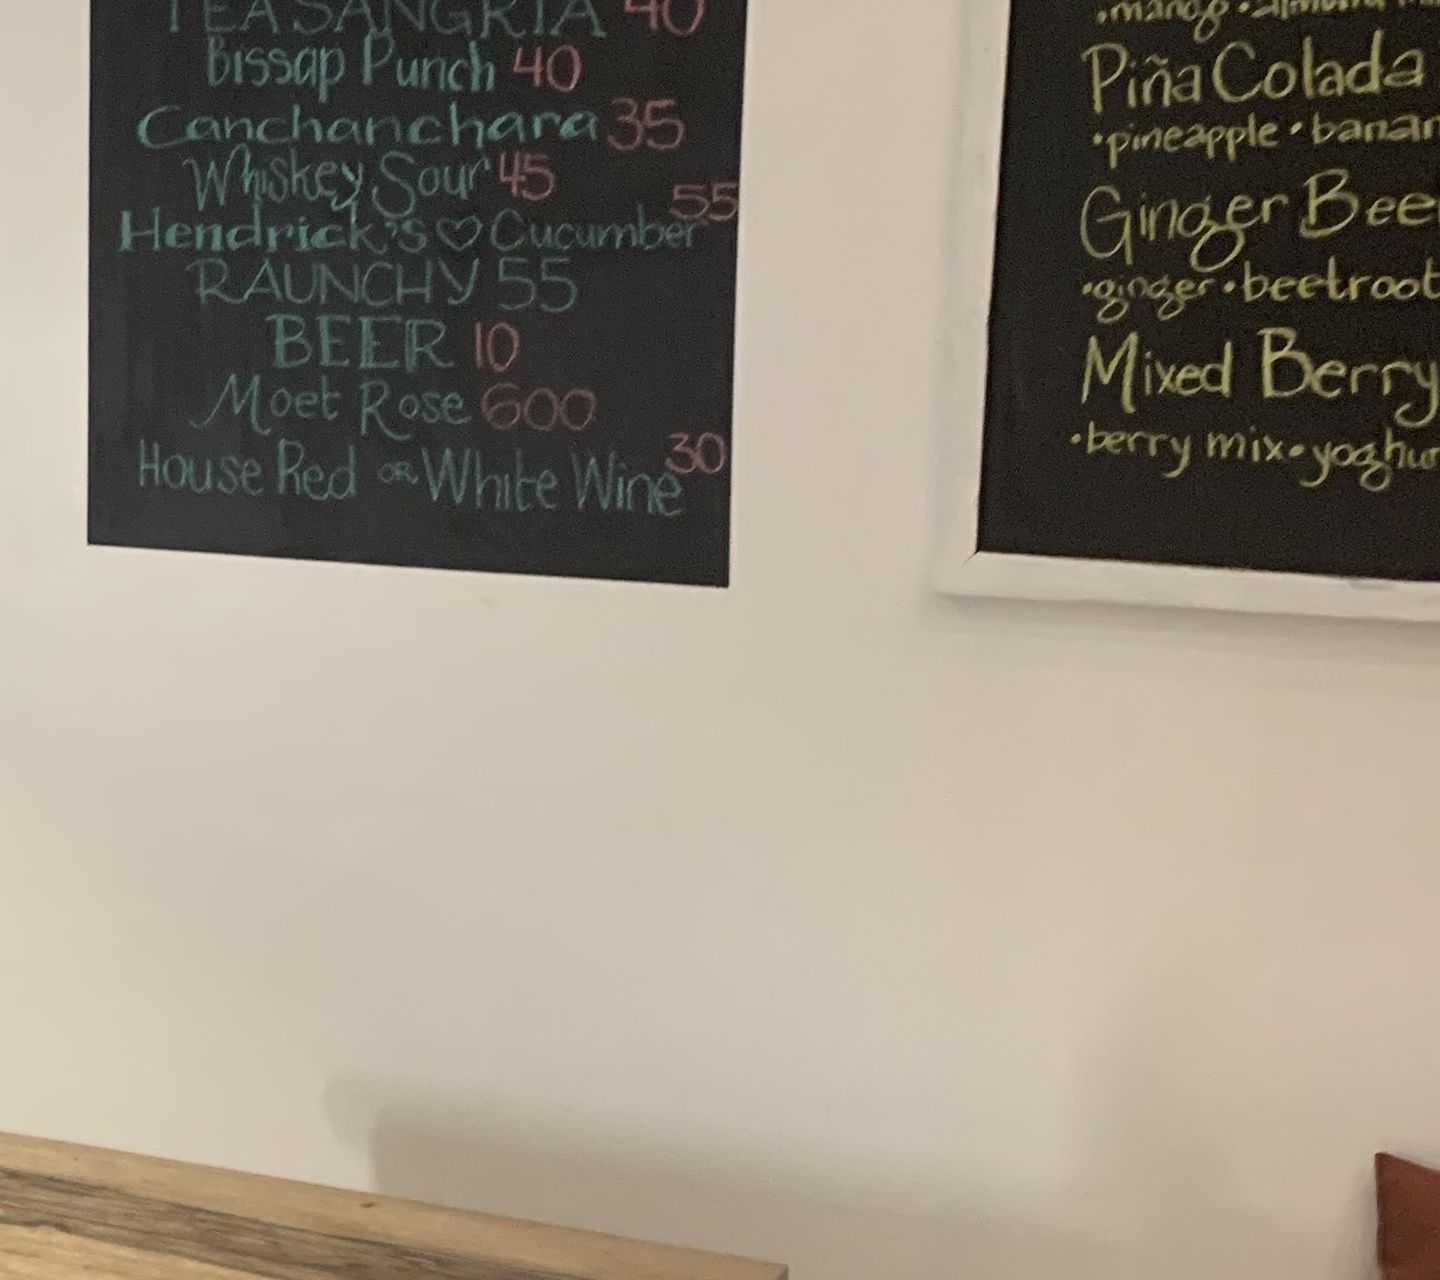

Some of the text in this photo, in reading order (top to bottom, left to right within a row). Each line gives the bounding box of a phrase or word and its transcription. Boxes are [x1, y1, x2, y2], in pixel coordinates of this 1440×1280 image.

[207, 29, 583, 105] Bissap Punch 40
[1080, 28, 1425, 115] Piña Colada
[136, 96, 687, 152] Canchanchara 35
[1105, 112, 1280, 170] pineapple
[182, 142, 557, 220] Whiskey Sour 45
[116, 181, 741, 256] Hendrick's Cucumber 55
[1079, 168, 1440, 273] Ginger Bee
[186, 256, 579, 314] RAUNCHY 55
[1087, 256, 1440, 325] ginger beetroot
[262, 312, 521, 373] BEER 10
[1080, 325, 1440, 429] Mixed Berry
[189, 373, 599, 442] Moet Rose 600
[136, 438, 263, 498] House
[275, 437, 358, 502] Red
[421, 445, 559, 513] White
[570, 450, 684, 518] Wine
[663, 430, 728, 476] 30
[1086, 419, 1191, 479] berry
[1206, 424, 1283, 462] mix
